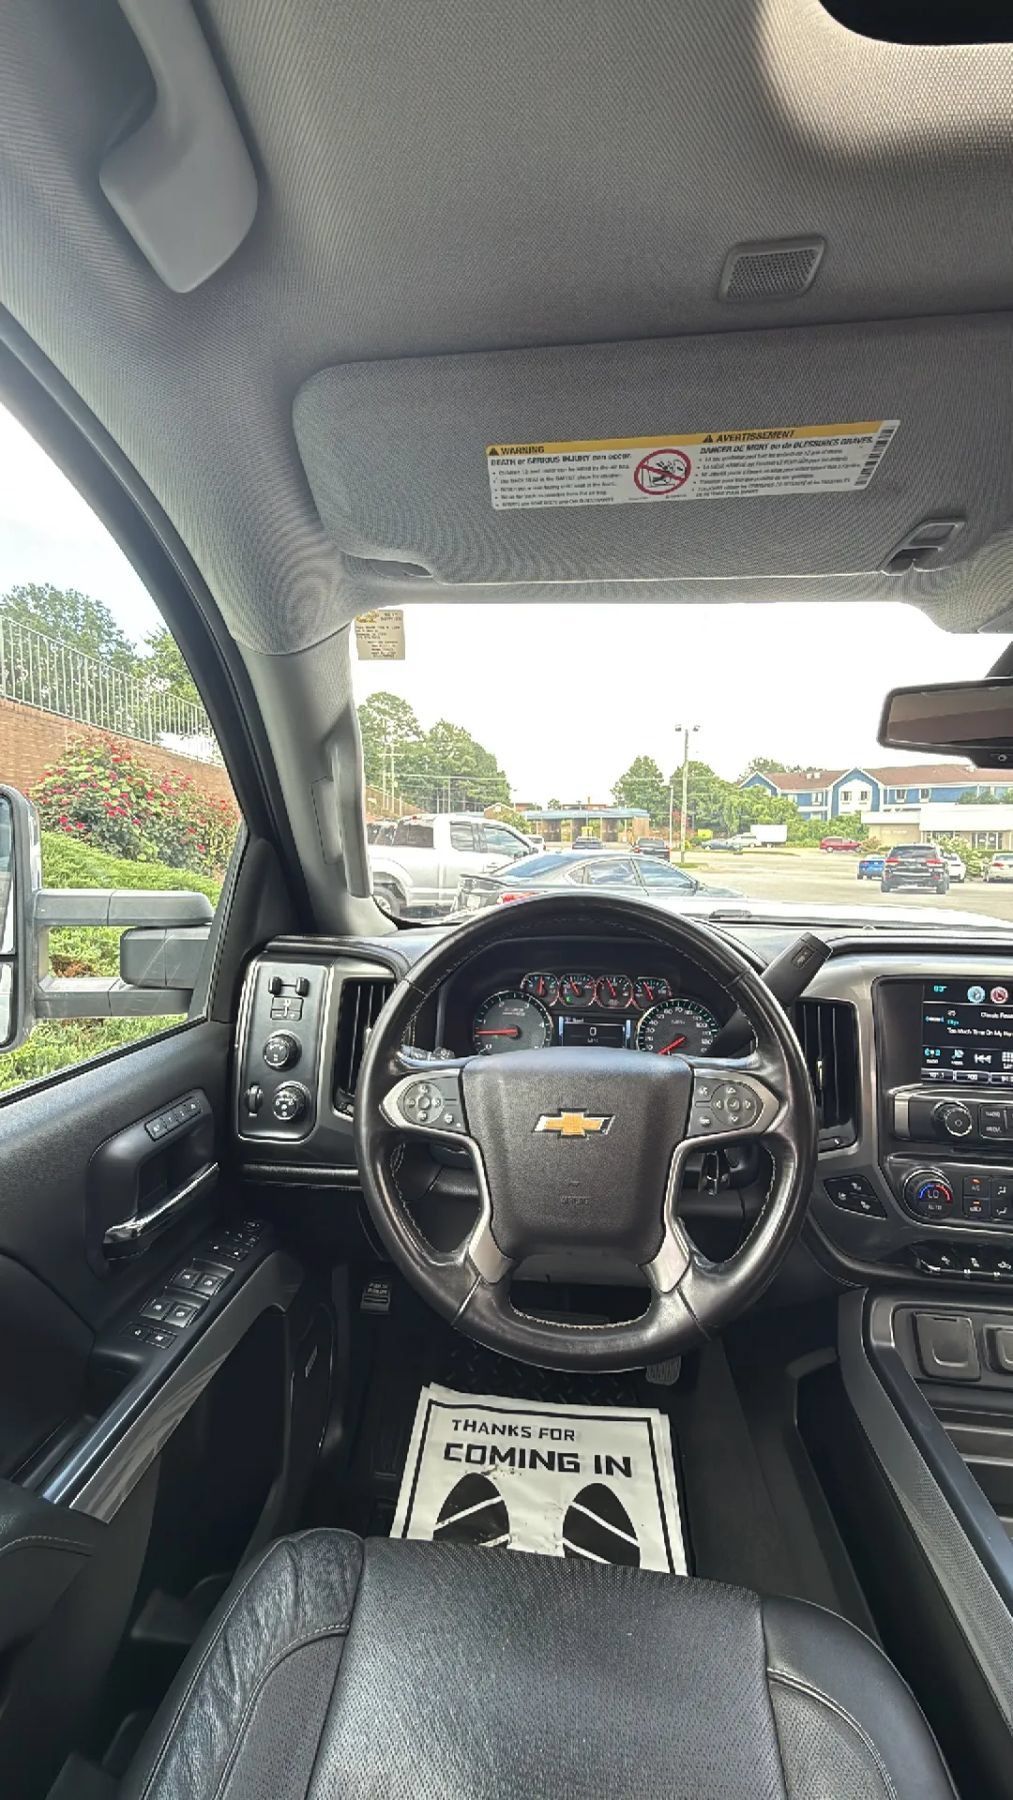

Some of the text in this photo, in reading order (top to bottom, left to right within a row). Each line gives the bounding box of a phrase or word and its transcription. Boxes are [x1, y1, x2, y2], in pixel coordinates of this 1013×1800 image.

[716, 430, 795, 442] AVERTISSEMENT
[500, 446, 545, 455] WARNING
[491, 458, 516, 466] DEATH
[527, 456, 560, 464] SERIOUS
[589, 1026, 597, 1036] 0
[927, 1190, 940, 1199] LO
[452, 1419, 575, 1442] THANKS FOR
[443, 1443, 632, 1478] COMING IN
